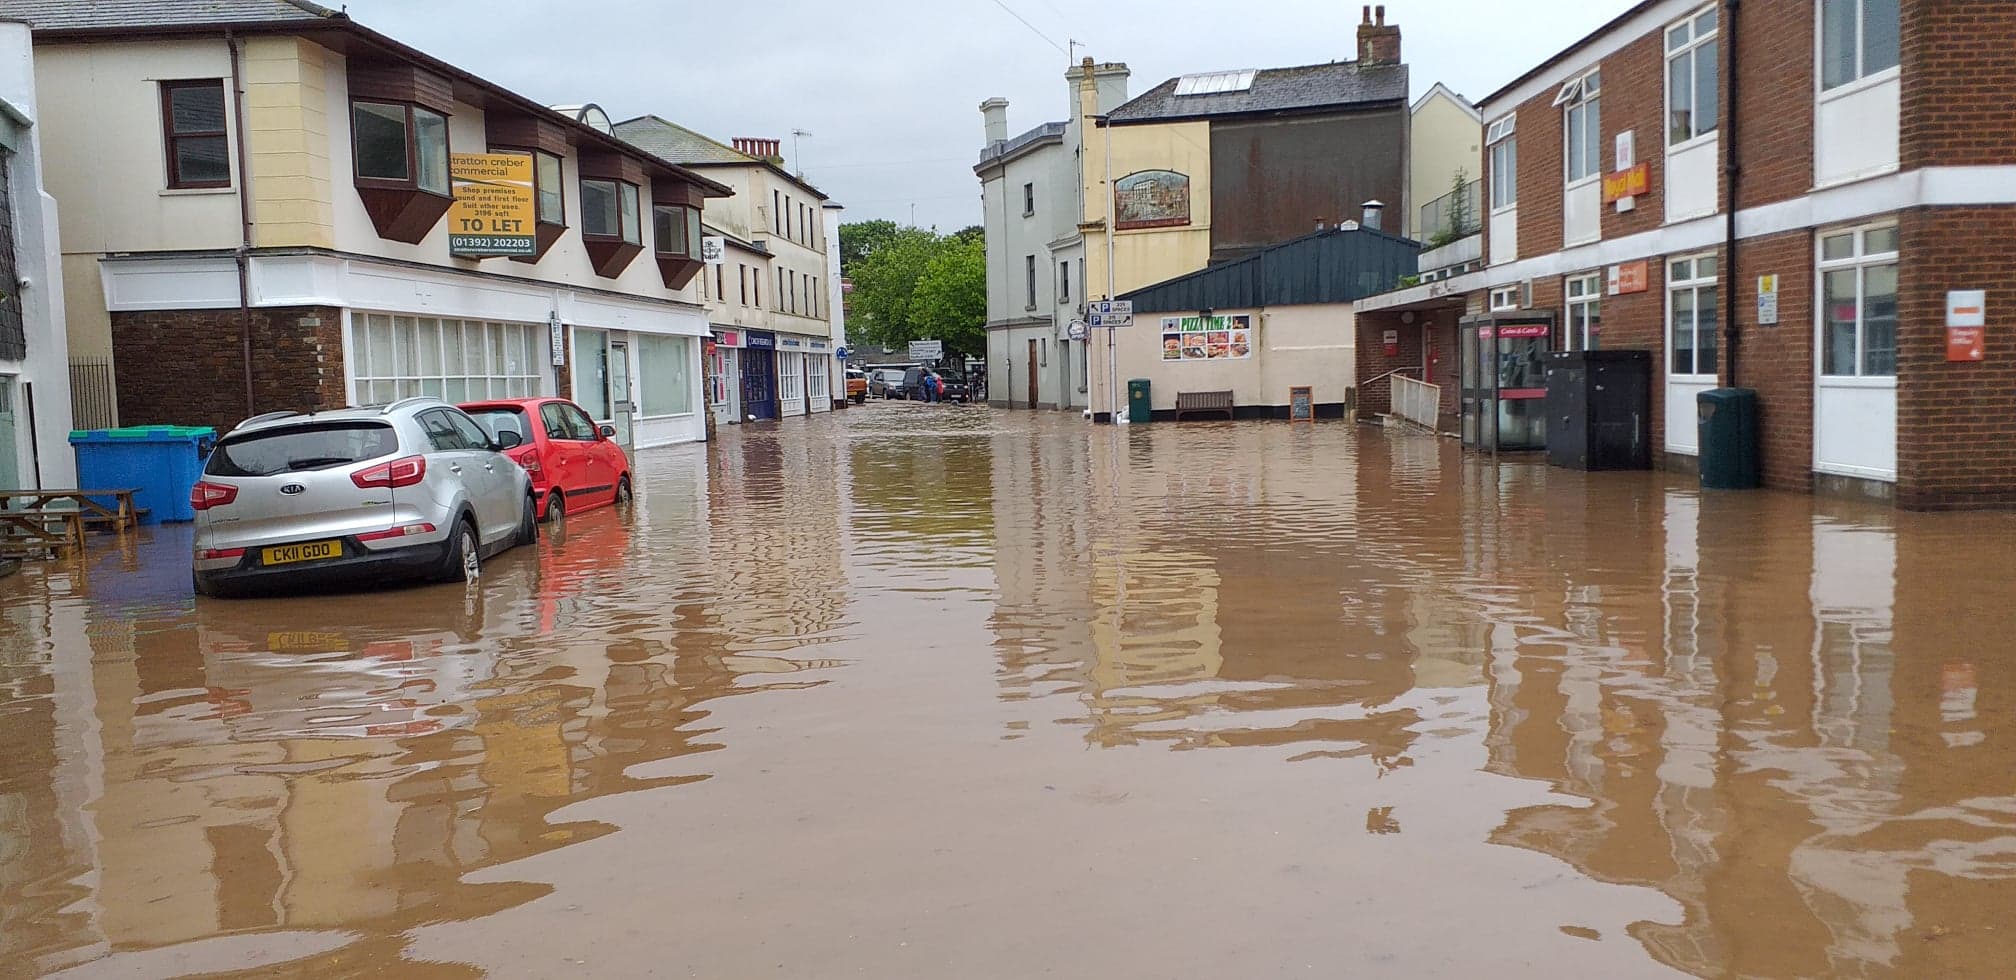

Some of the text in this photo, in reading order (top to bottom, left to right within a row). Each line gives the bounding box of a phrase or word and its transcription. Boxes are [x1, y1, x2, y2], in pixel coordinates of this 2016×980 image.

[451, 157, 525, 167] tratton creber
[463, 186, 480, 194] Shop
[460, 218, 522, 232] TO LET
[453, 238, 530, 247] (01392) 202203
[1182, 317, 1203, 331] PIZZA
[1206, 316, 1225, 330] TIME
[283, 485, 302, 494] KIA
[274, 543, 331, 562] CK11 GDO
